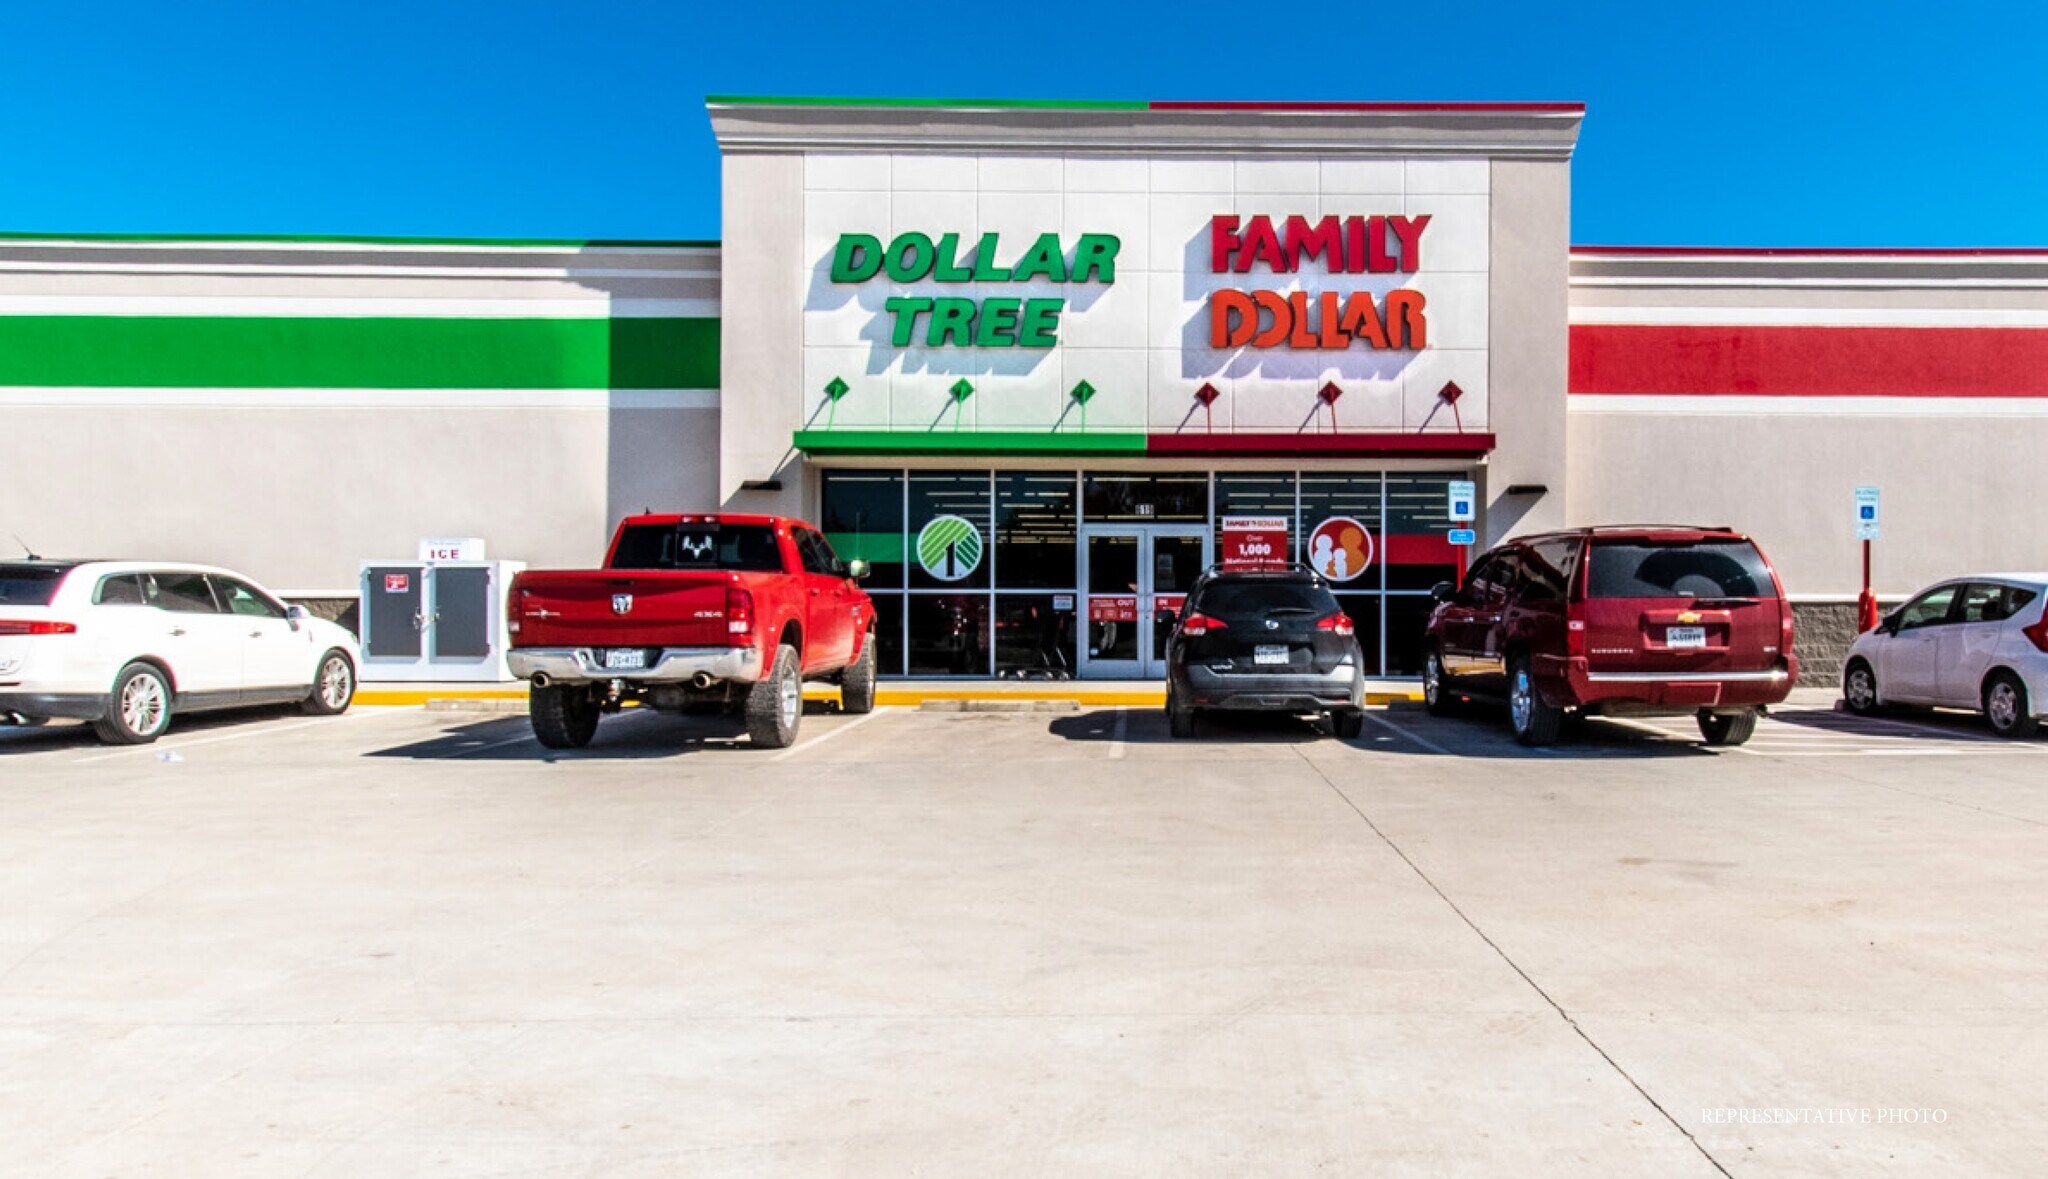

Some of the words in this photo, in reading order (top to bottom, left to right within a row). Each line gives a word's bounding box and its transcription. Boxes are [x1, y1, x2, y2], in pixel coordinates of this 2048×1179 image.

[830, 231, 1121, 283] DOLLAR
[1211, 214, 1432, 273] FAMILY
[885, 296, 1065, 347] TREE
[1211, 288, 1427, 349] DOLLAR
[430, 548, 460, 559] ICE
[1239, 543, 1271, 557] 1,000
